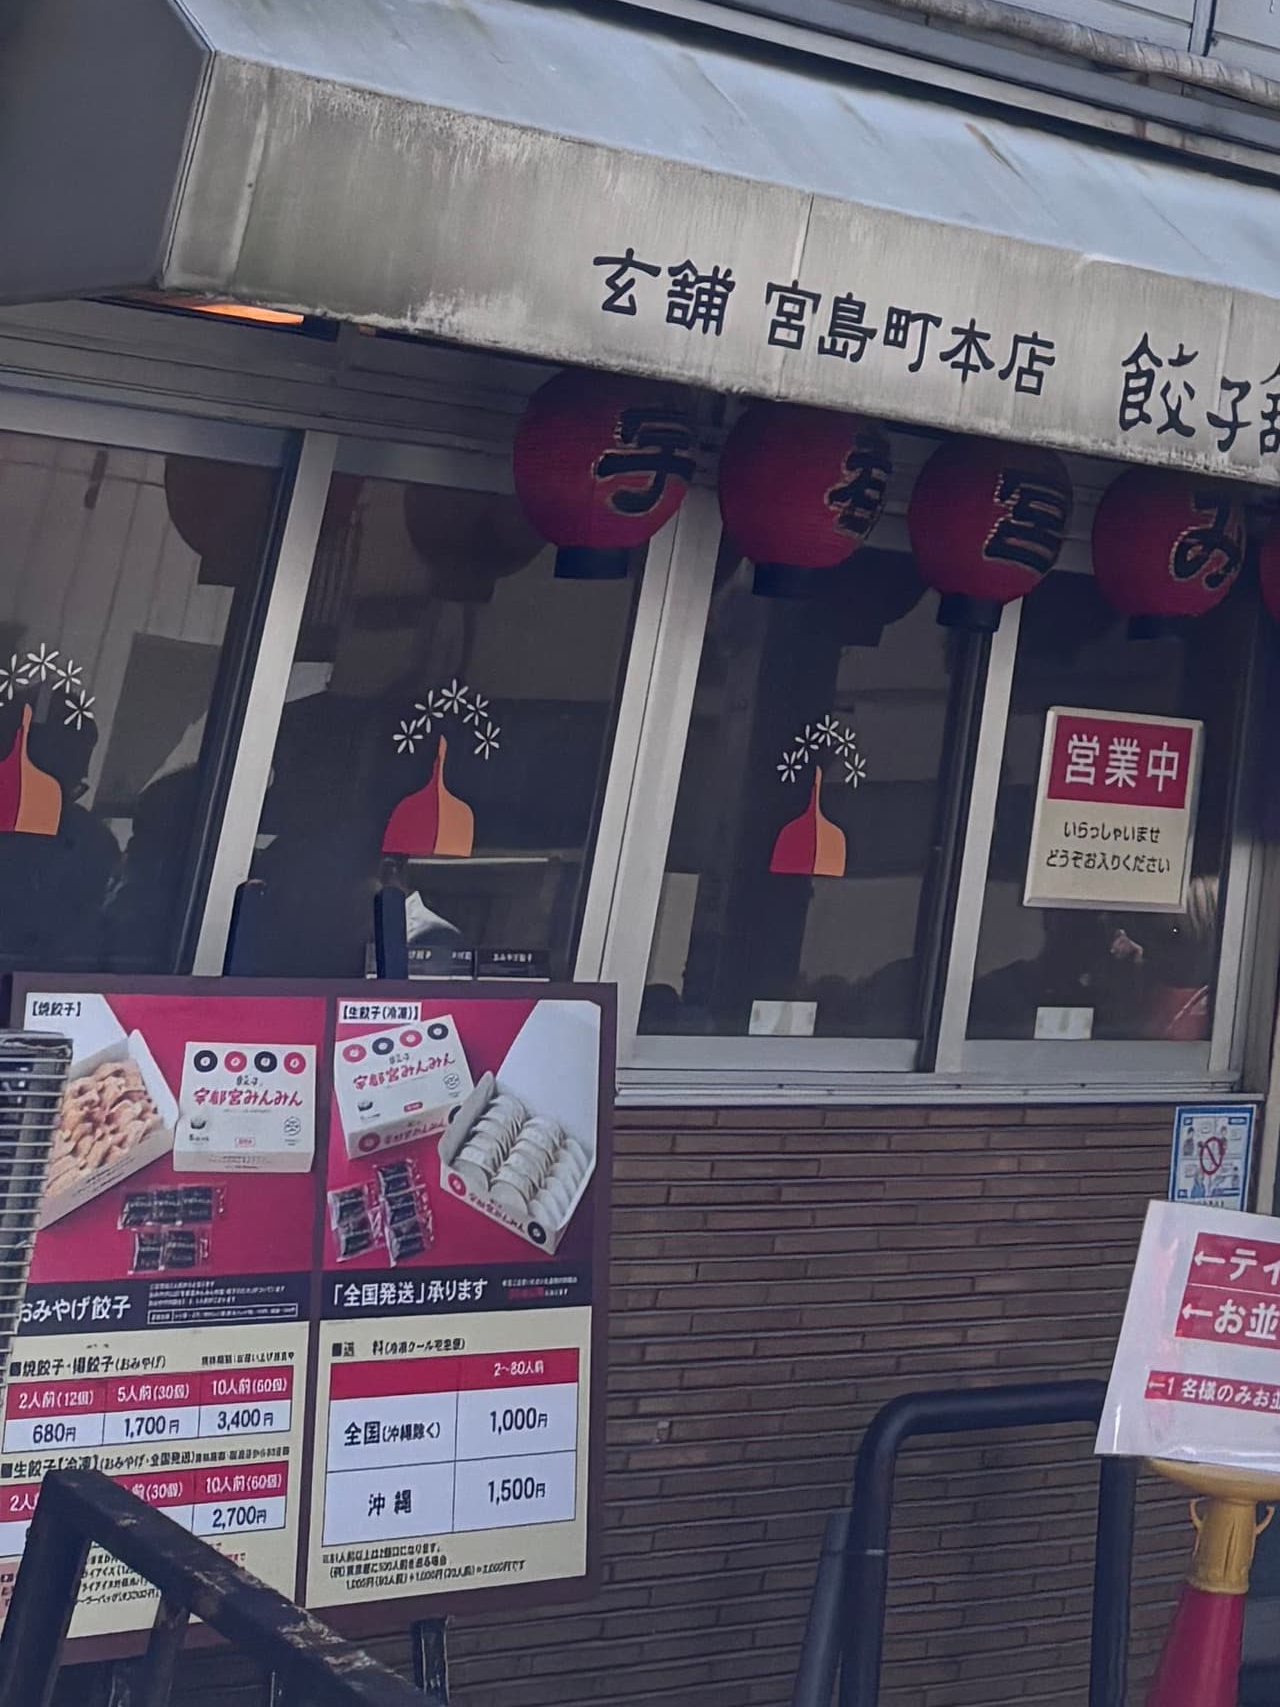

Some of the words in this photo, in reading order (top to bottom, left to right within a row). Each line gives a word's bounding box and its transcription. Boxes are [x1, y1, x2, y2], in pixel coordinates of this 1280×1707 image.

[592, 247, 734, 337] 玄舗
[765, 279, 1056, 396] 宮島町本店
[1065, 731, 1182, 793] 営業中
[1063, 819, 1162, 844] いらっしゃいませ
[1045, 847, 1172, 875] どうぞお入りください
[333, 1278, 488, 1307] 「全国発送」承ります
[19, 1295, 132, 1324] おみやげ餃子
[32, 1423, 77, 1444] 680円
[124, 1415, 180, 1439] 1,700円
[216, 1409, 274, 1430] 3,400円
[489, 1407, 548, 1436] 1,000円
[487, 1476, 546, 1506] 1,500円
[212, 1505, 267, 1528] 2,700円
